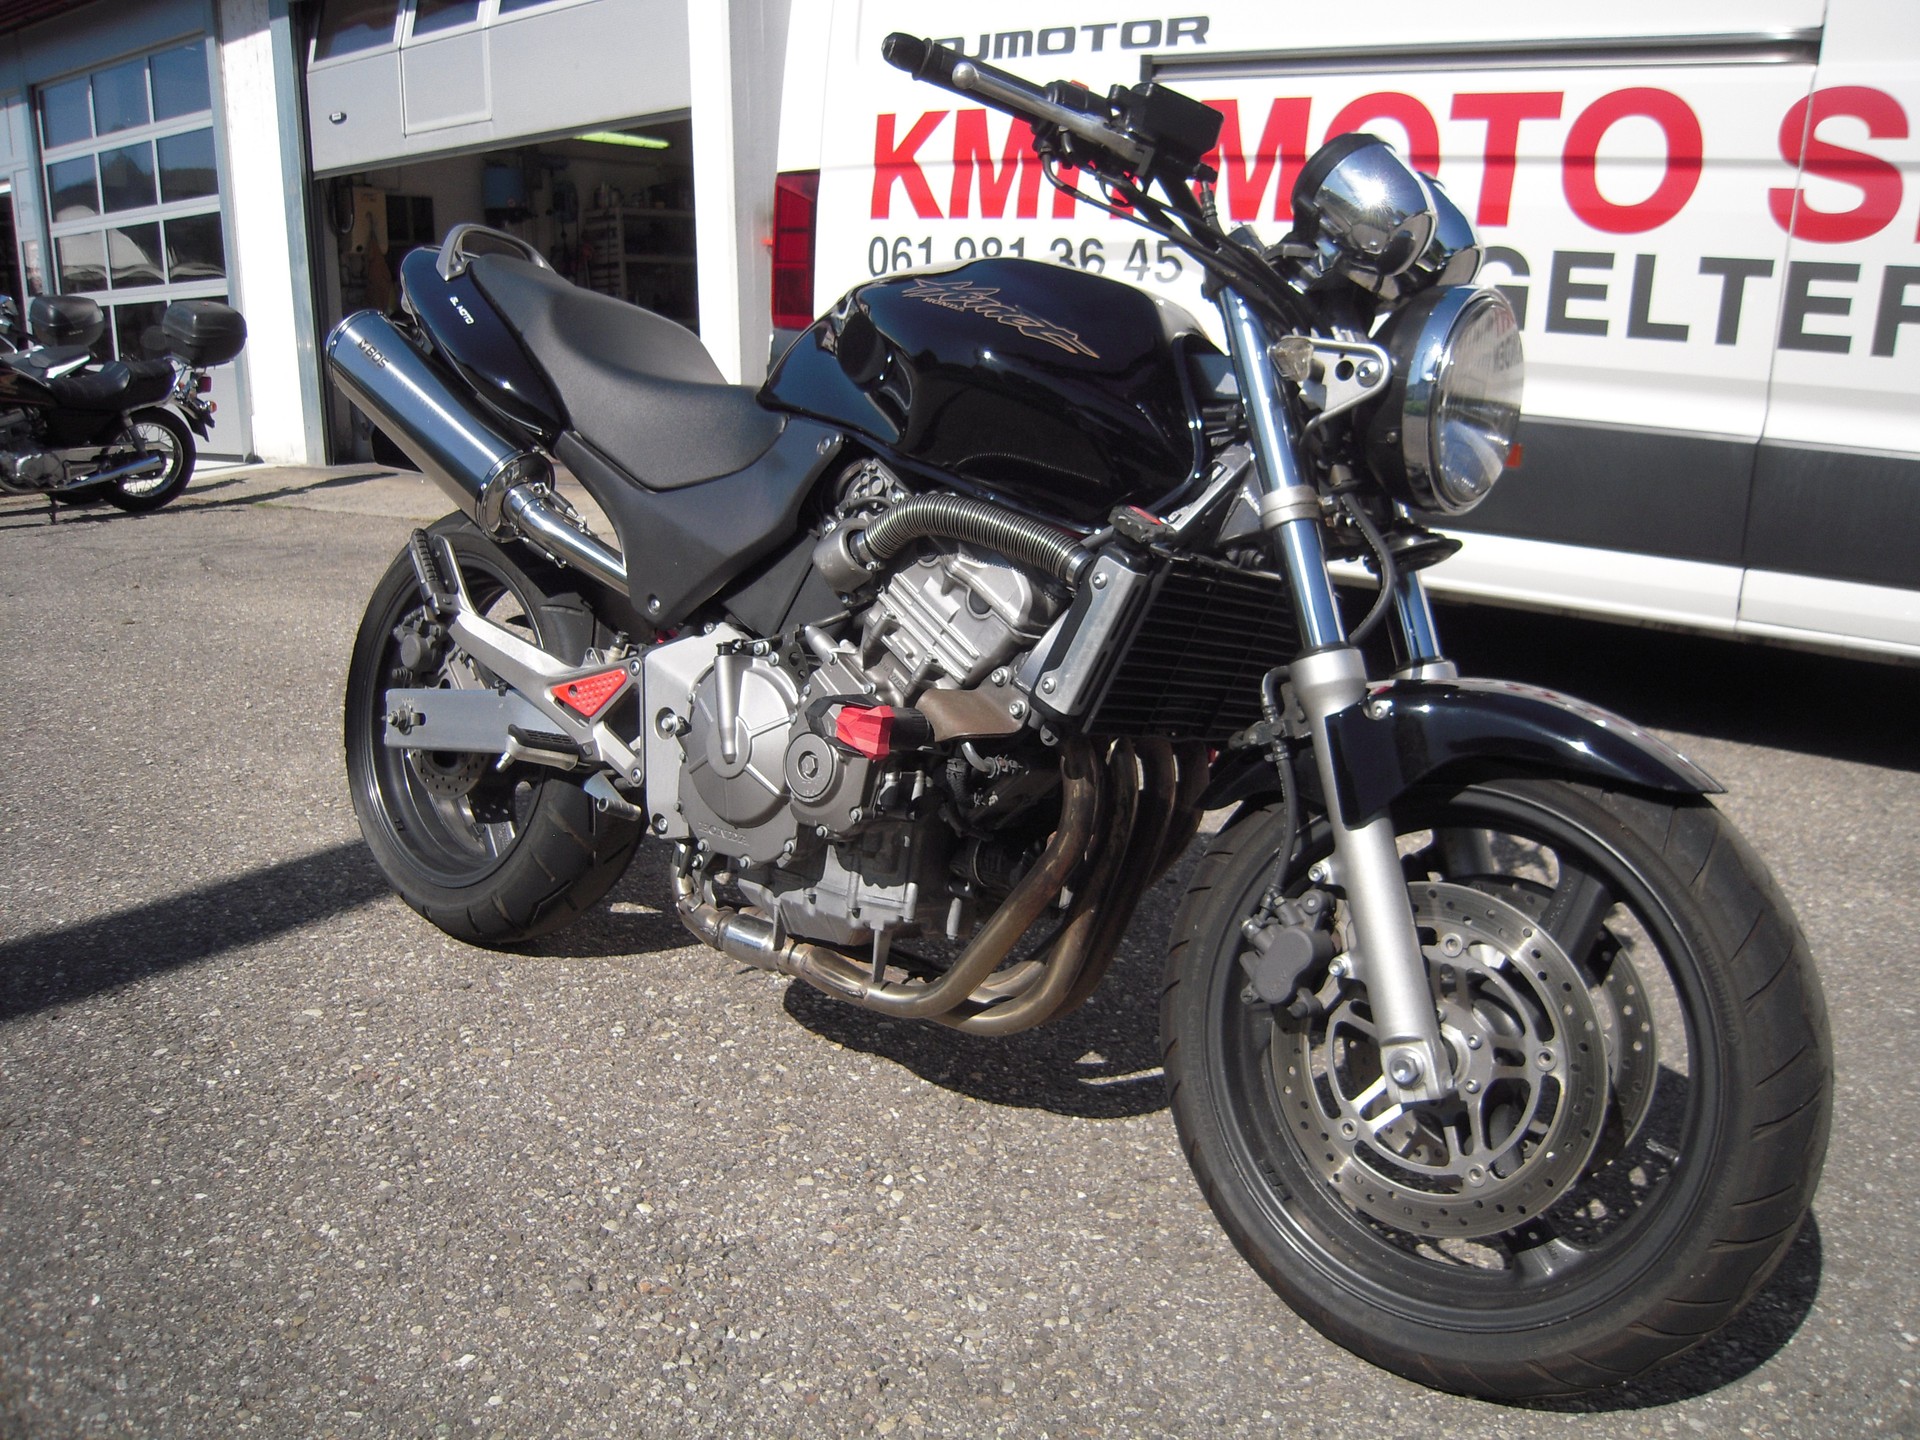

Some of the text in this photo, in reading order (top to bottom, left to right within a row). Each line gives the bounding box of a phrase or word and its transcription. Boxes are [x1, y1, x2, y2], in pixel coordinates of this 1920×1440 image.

[870, 108, 1138, 219] KM
[1769, 85, 1920, 244] S
[868, 236, 932, 277] 061
[1050, 238, 1105, 271] 36
[1123, 238, 1183, 284] 45
